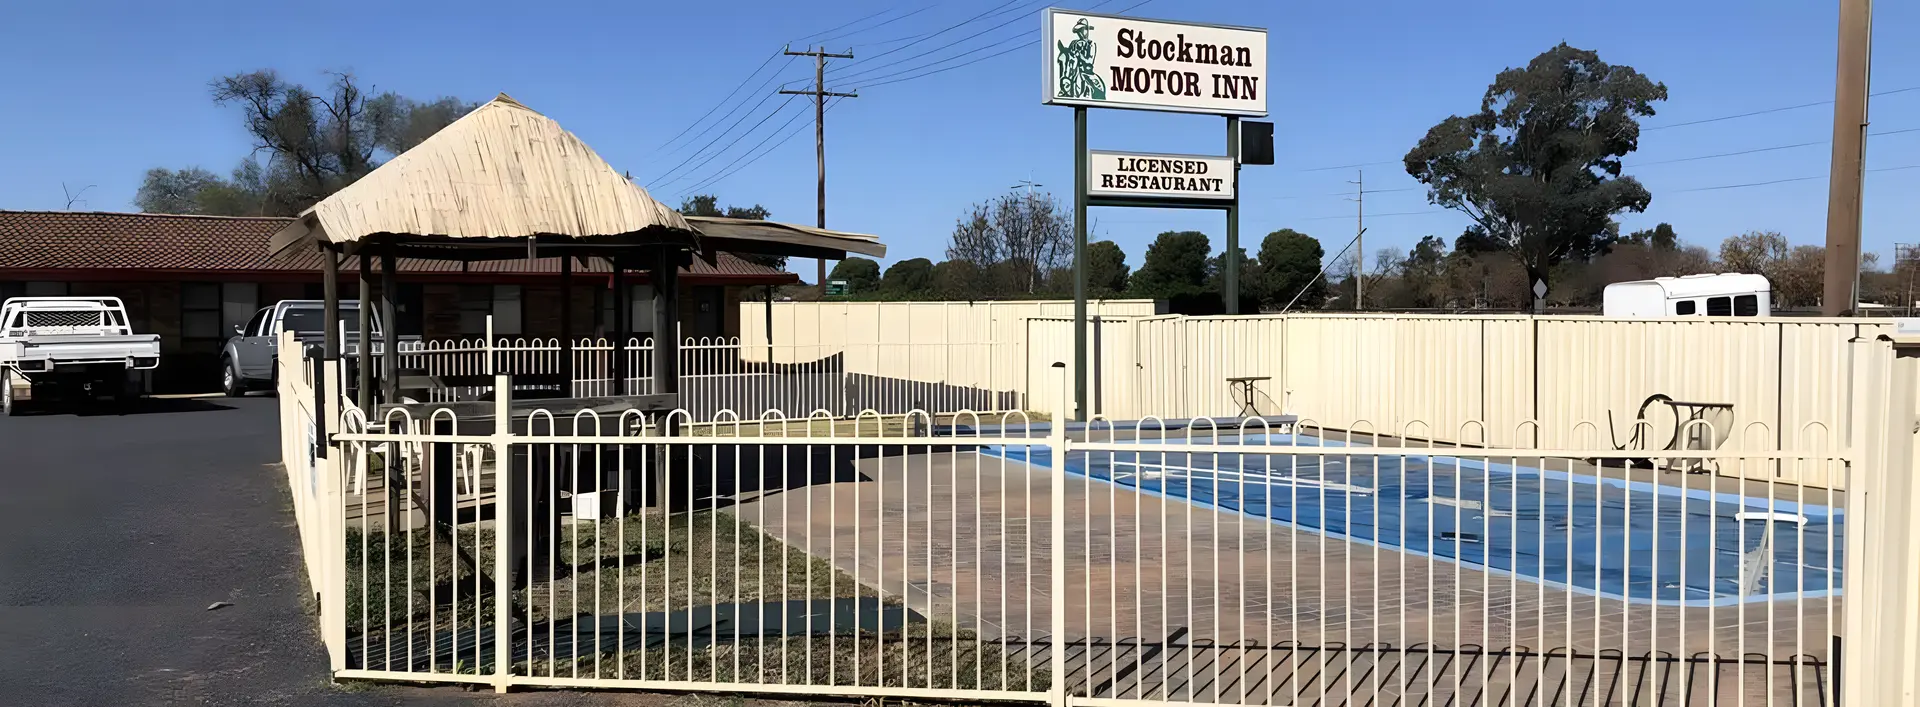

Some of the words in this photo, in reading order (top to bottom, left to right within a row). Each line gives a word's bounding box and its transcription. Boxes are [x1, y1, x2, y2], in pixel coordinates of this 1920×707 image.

[1117, 28, 1252, 67] Stockman
[1110, 66, 1201, 97] MOTOR
[1212, 74, 1258, 100] INN
[1117, 158, 1208, 175] LICENSED
[1101, 174, 1223, 192] RESTAURANT
